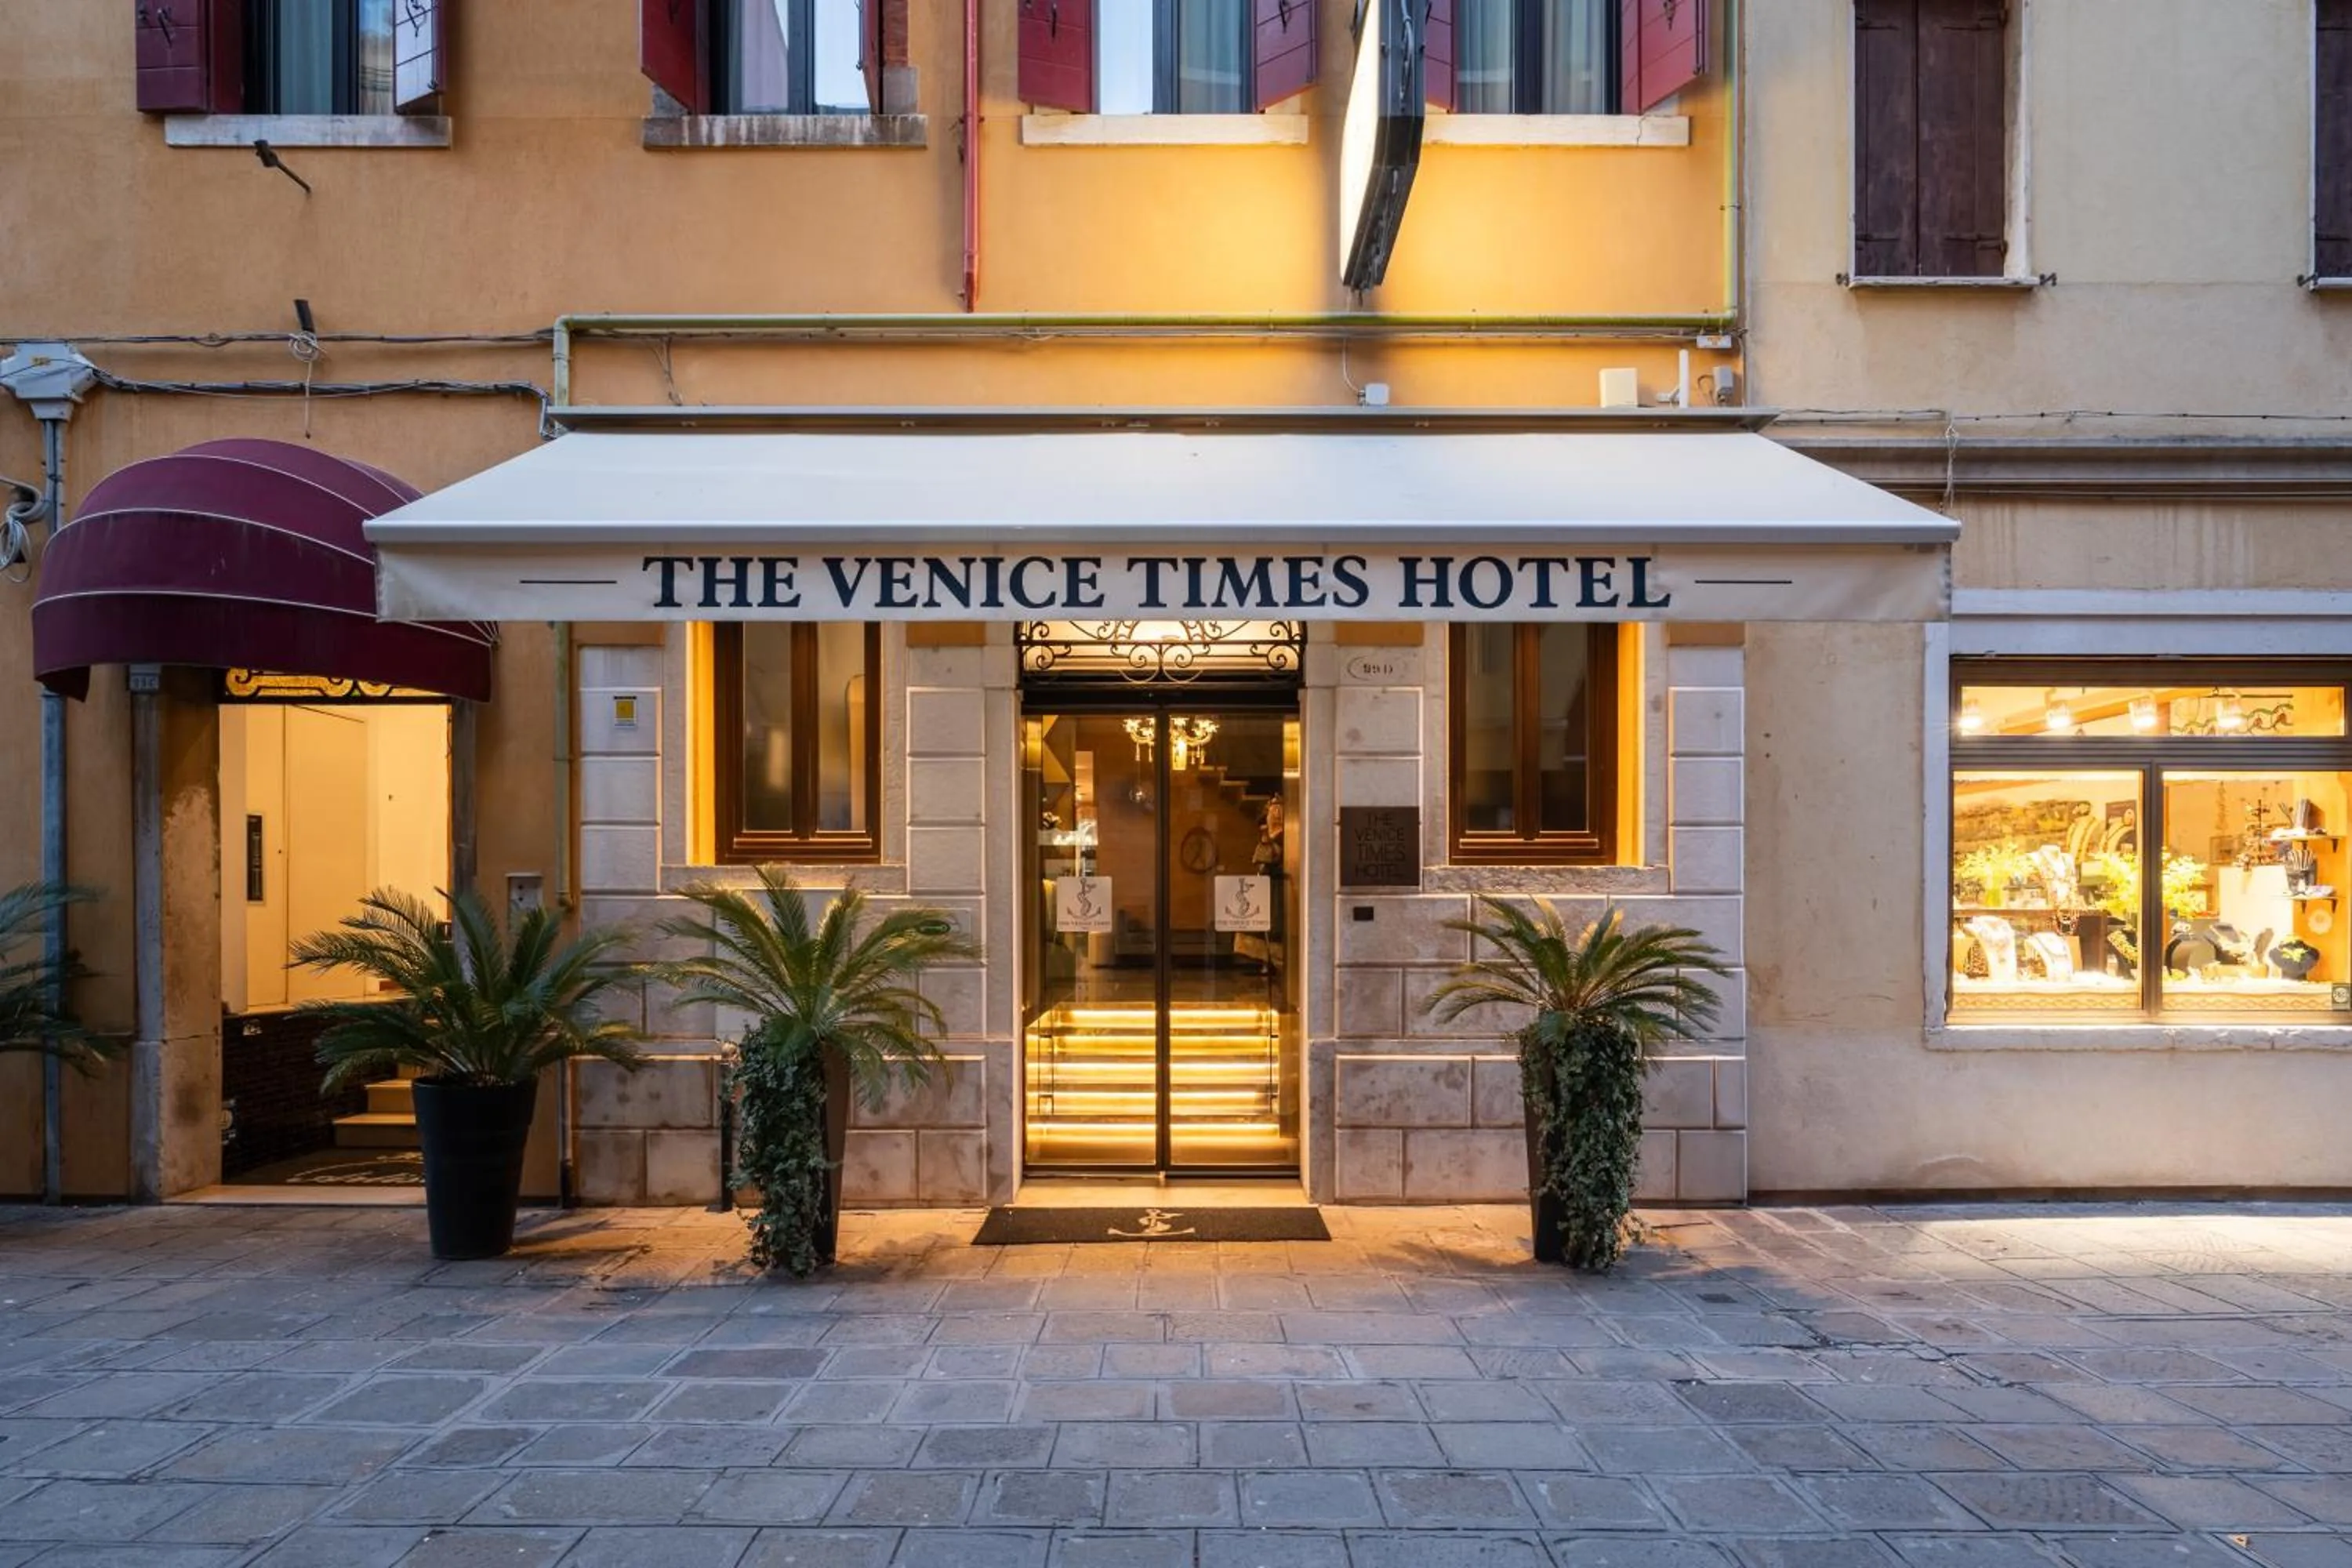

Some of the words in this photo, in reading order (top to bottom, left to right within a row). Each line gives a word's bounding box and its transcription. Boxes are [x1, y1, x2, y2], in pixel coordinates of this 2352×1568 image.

[642, 556, 801, 608] THE
[821, 556, 1105, 608] VENICE
[1127, 555, 1370, 608] TIMES
[1398, 555, 1671, 608] HOTEL
[1365, 811, 1393, 826] THE
[1354, 827, 1406, 841] VENICE
[1356, 843, 1406, 862] TIMES
[1355, 863, 1404, 878] HOTEL
